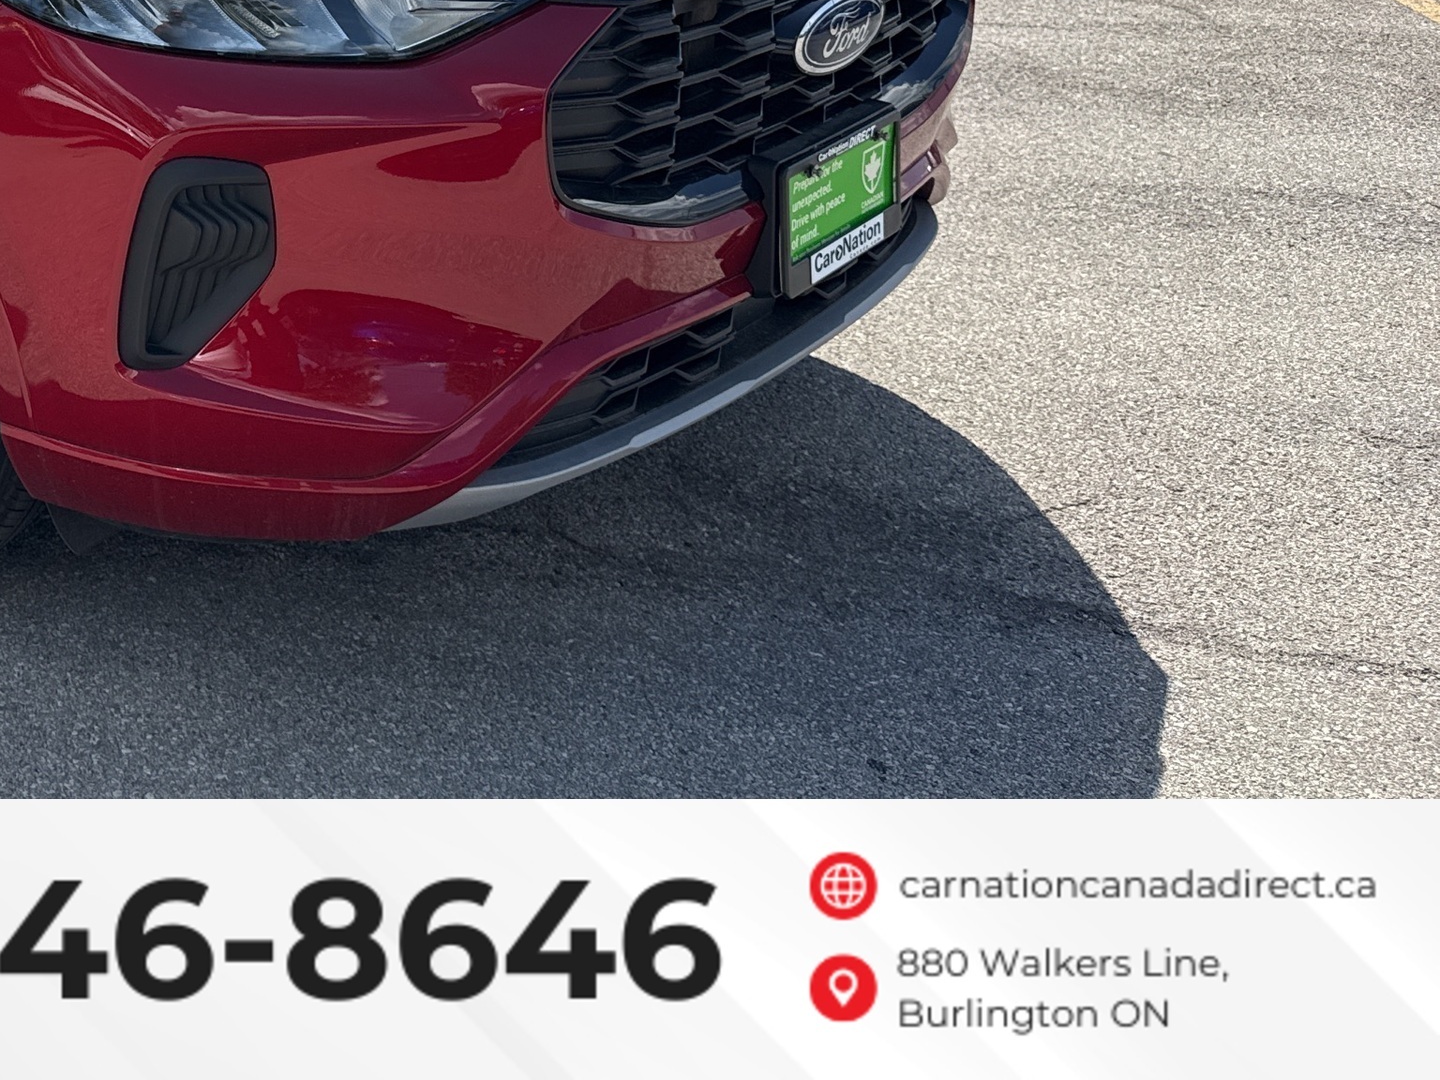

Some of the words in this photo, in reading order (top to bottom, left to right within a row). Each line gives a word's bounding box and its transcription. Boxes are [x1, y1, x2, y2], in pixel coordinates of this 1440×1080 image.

[822, 7, 871, 59] Ford
[848, 125, 877, 149] DIRECT
[791, 214, 810, 232] Drive
[810, 204, 825, 220] with
[825, 193, 846, 215] peace
[791, 234, 800, 251] of
[814, 252, 836, 273] Car
[842, 221, 881, 254] Nation
